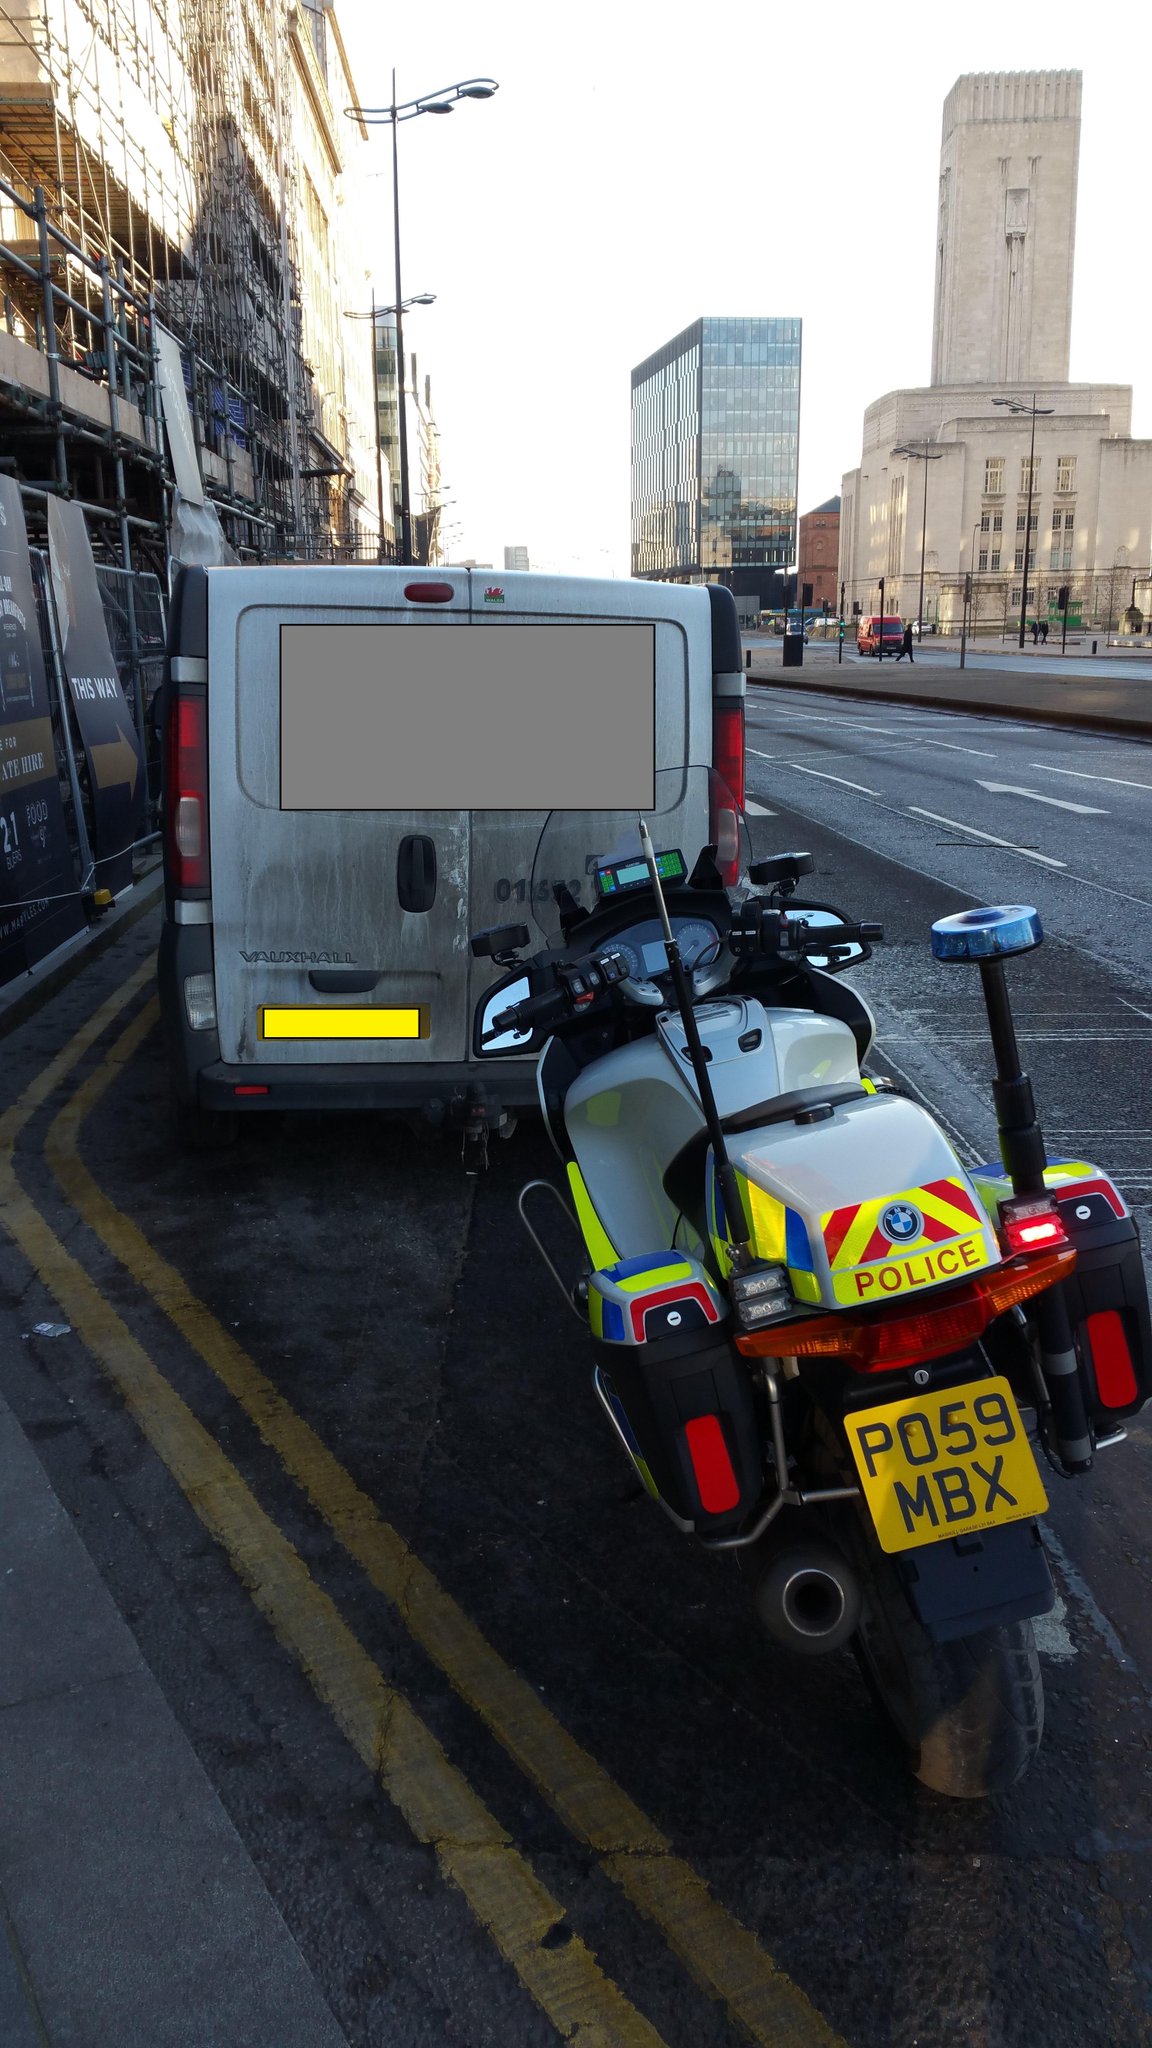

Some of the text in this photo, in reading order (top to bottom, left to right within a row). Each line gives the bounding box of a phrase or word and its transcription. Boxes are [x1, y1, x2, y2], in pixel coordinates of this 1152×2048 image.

[71, 677, 119, 700] THIS WAY
[21, 752, 44, 774] HIRE
[25, 800, 49, 827] FOOD
[239, 950, 358, 964] VAUXHALL
[886, 1206, 913, 1220] BMW
[854, 1240, 980, 1297] POLICE
[856, 1393, 1016, 1478] PO59
[893, 1455, 1018, 1533] MBX
